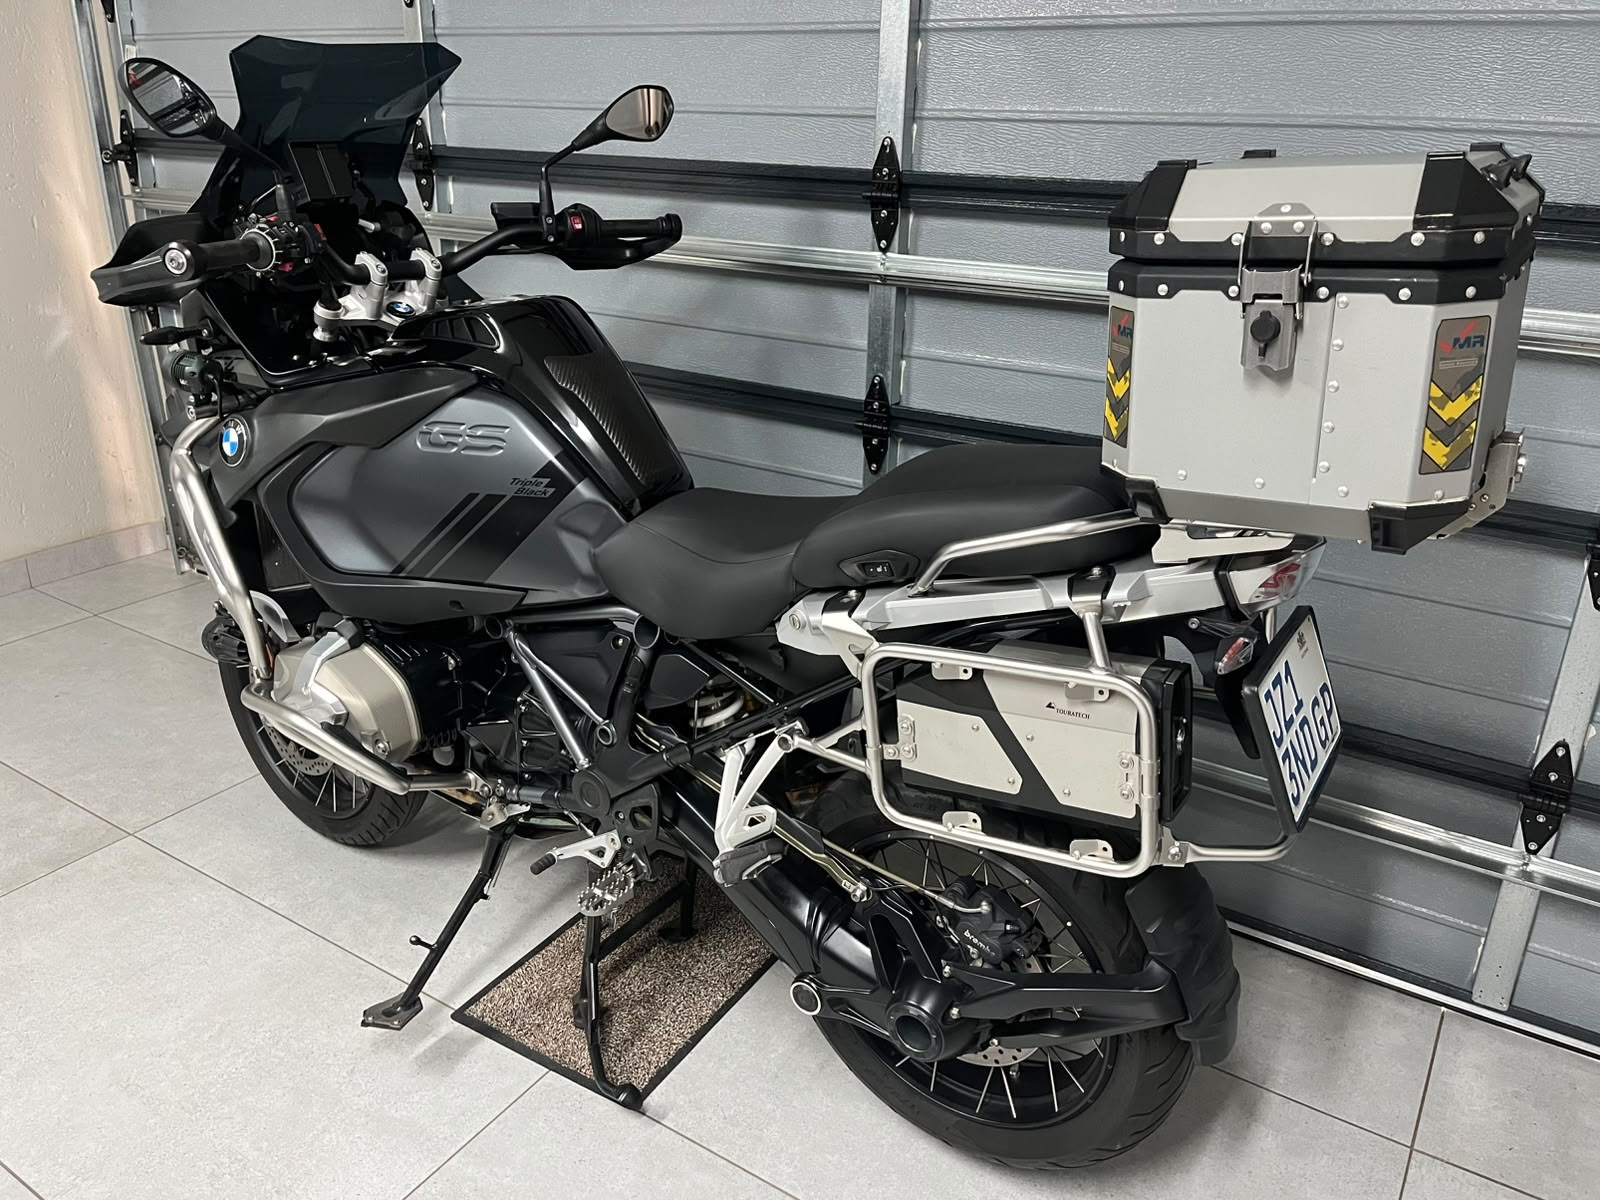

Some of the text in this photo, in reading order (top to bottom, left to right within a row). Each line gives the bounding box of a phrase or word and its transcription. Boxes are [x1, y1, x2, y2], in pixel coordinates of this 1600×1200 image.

[416, 420, 510, 456] GS
[510, 477, 543, 488] Triple
[514, 487, 549, 496] Black
[1056, 708, 1090, 719] TOURATECH
